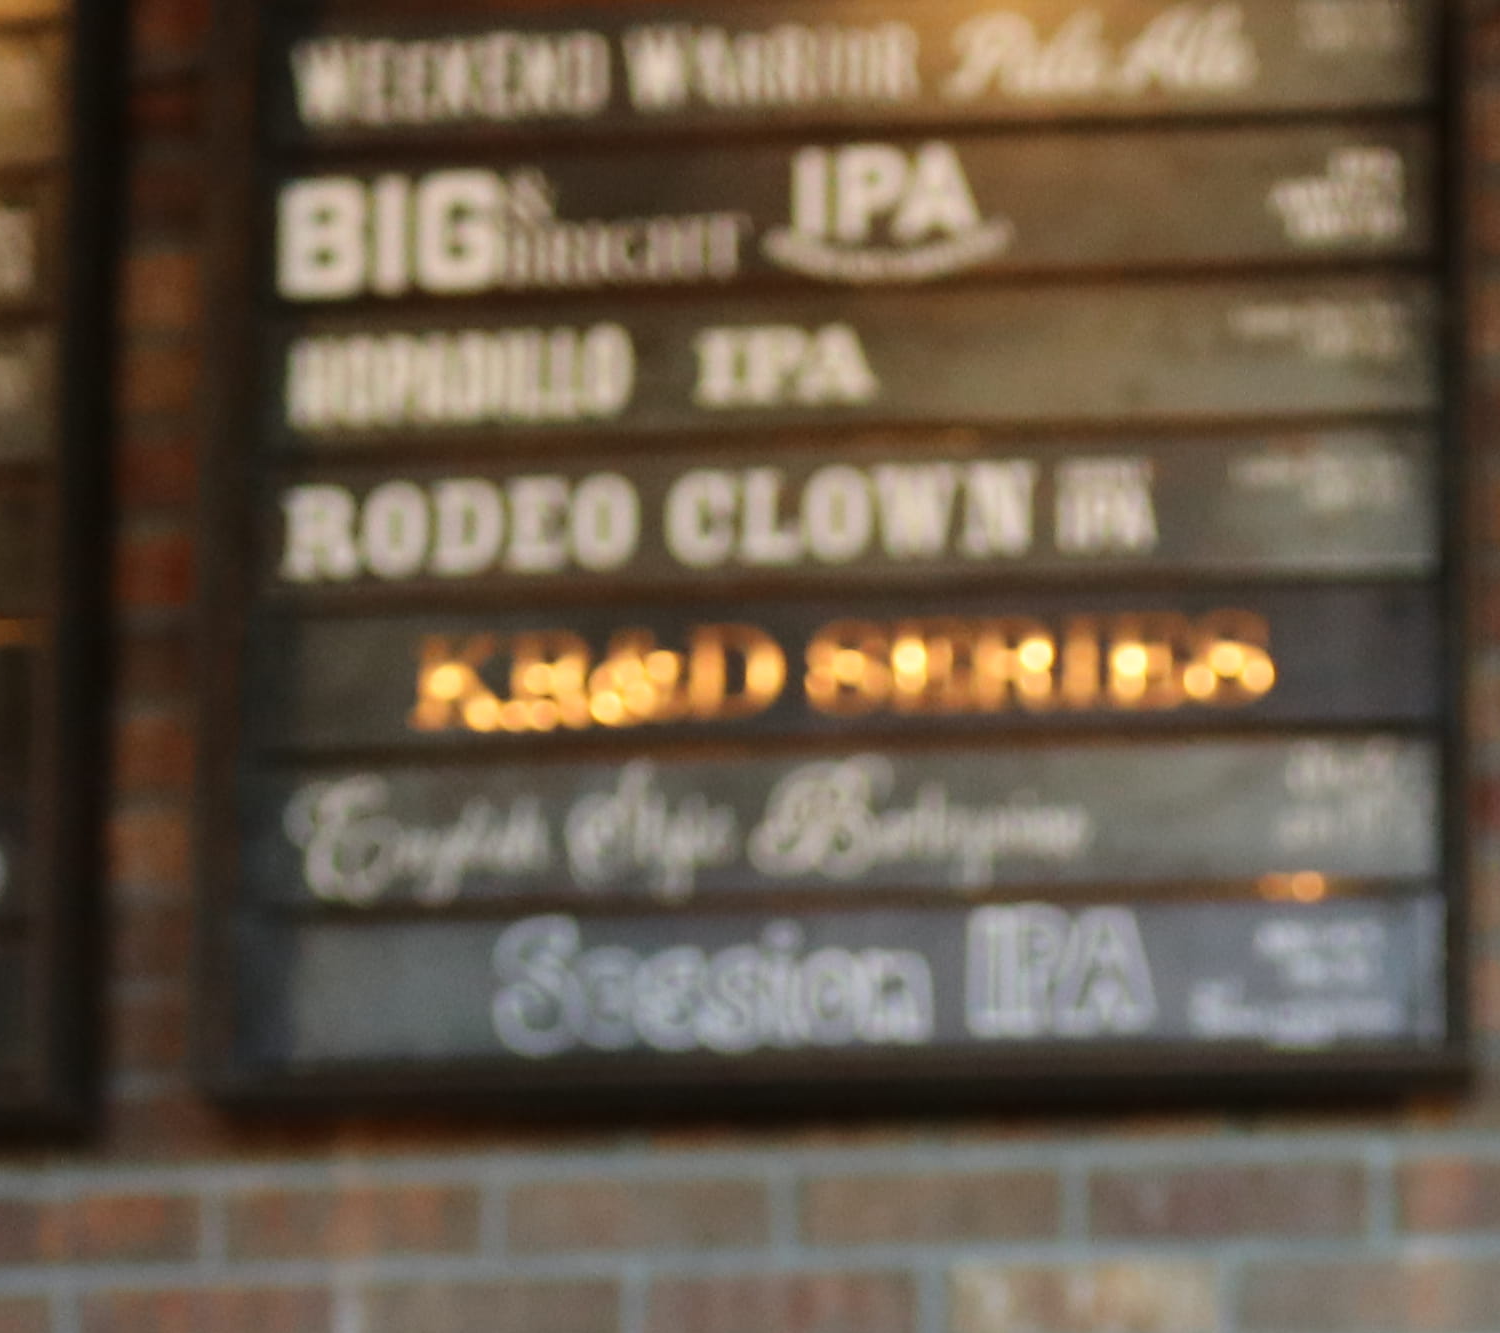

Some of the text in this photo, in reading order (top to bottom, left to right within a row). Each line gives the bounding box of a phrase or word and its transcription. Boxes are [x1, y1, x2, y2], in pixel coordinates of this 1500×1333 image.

[274, 166, 504, 302] BIG
[786, 138, 984, 244] IPA
[692, 320, 882, 410] IPA
[276, 470, 642, 584] RODEO
[662, 455, 1040, 568] CLOWN
[962, 900, 1162, 1042] IPA
